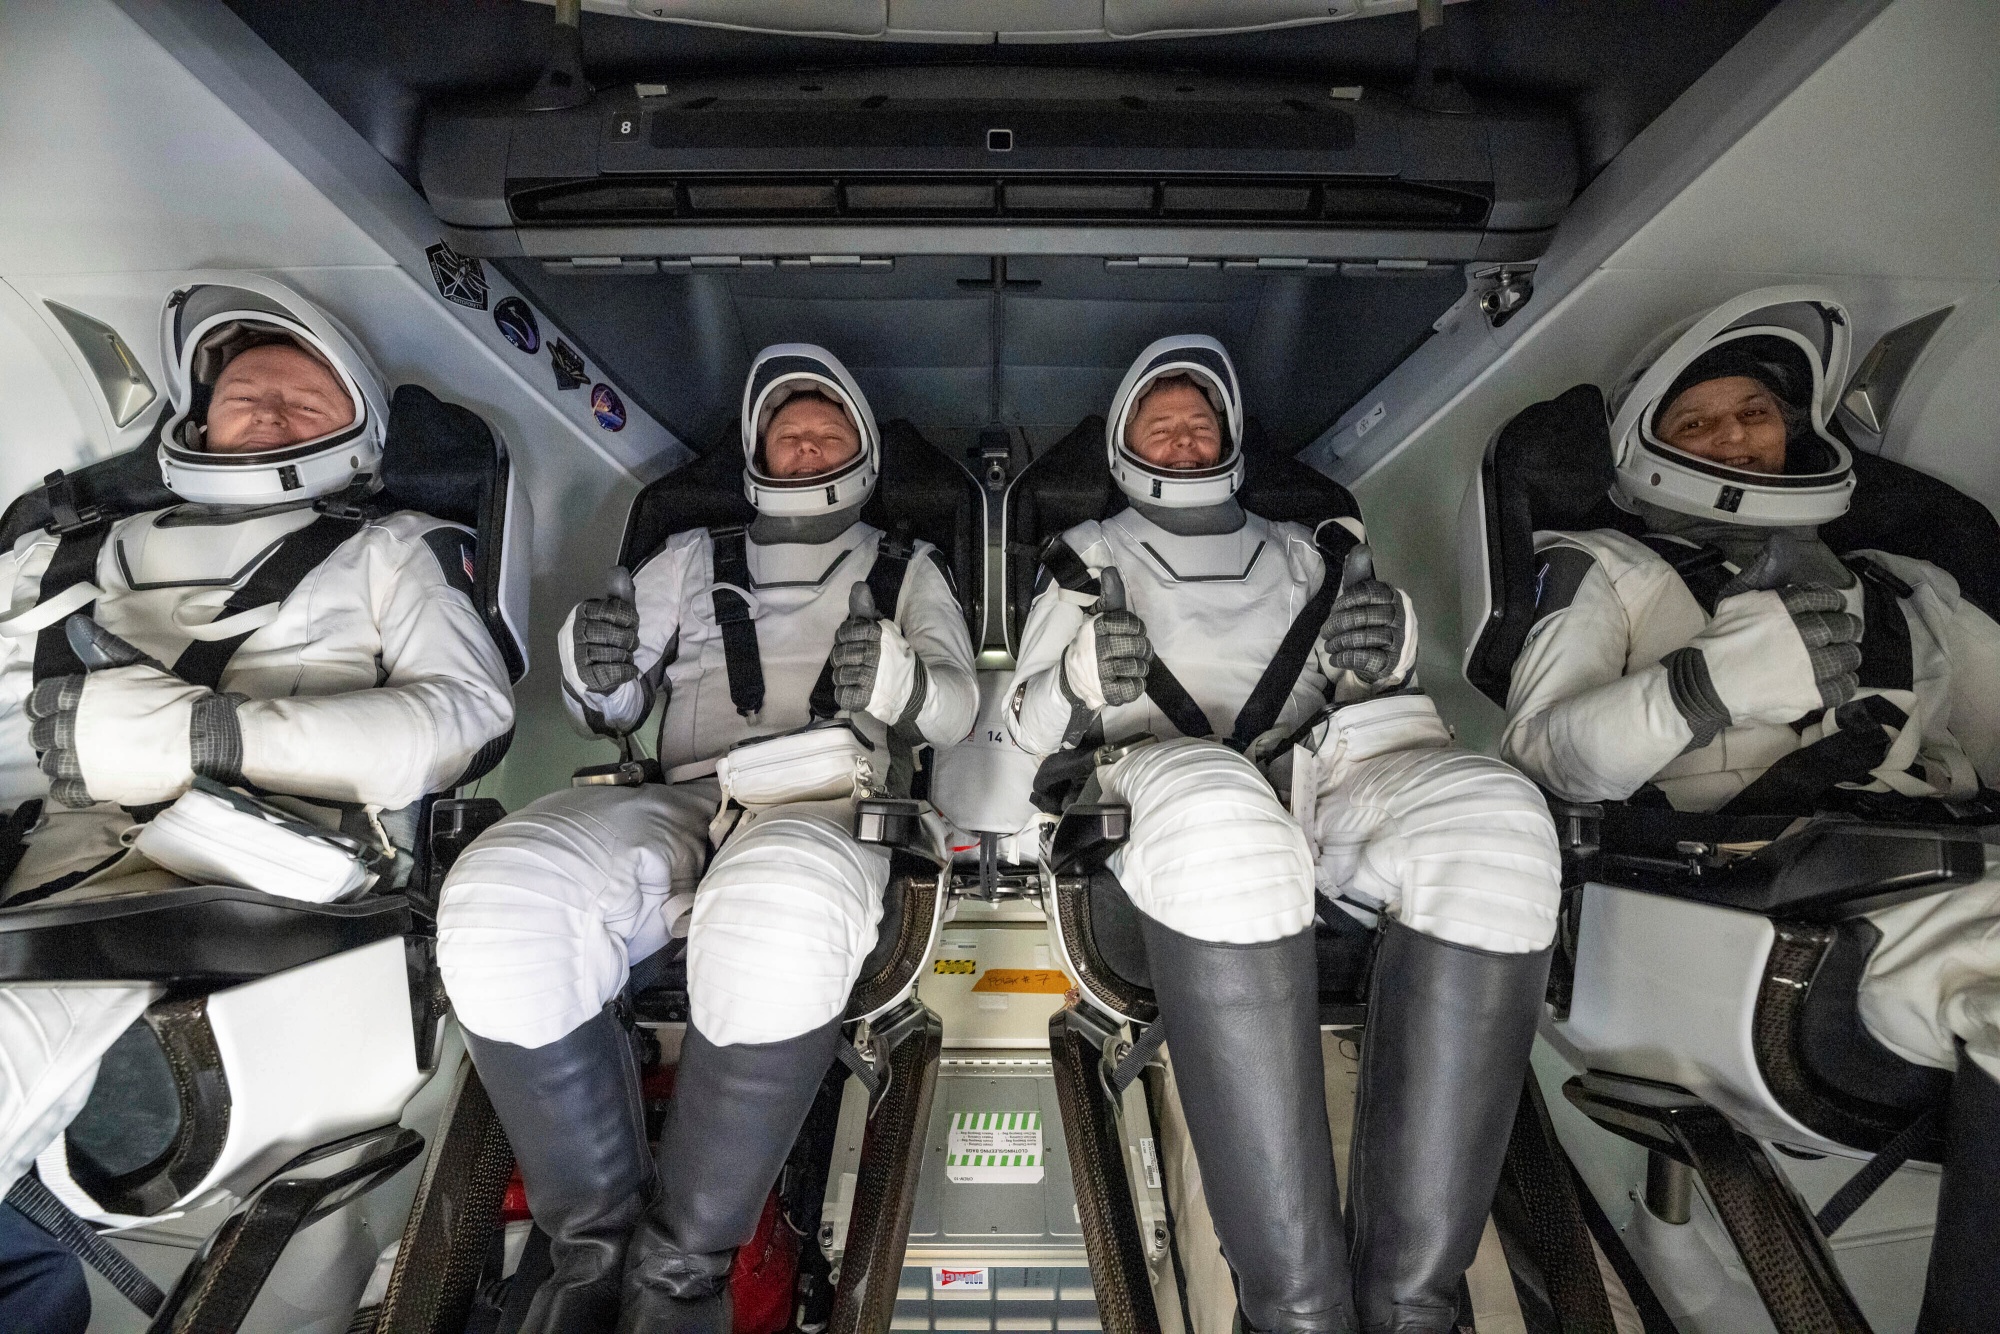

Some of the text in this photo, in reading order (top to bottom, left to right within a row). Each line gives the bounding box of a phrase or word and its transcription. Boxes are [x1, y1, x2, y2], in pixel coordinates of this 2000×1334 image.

[621, 121, 631, 134] 8
[987, 730, 1003, 743] 14
[1035, 973, 1050, 986] 7
